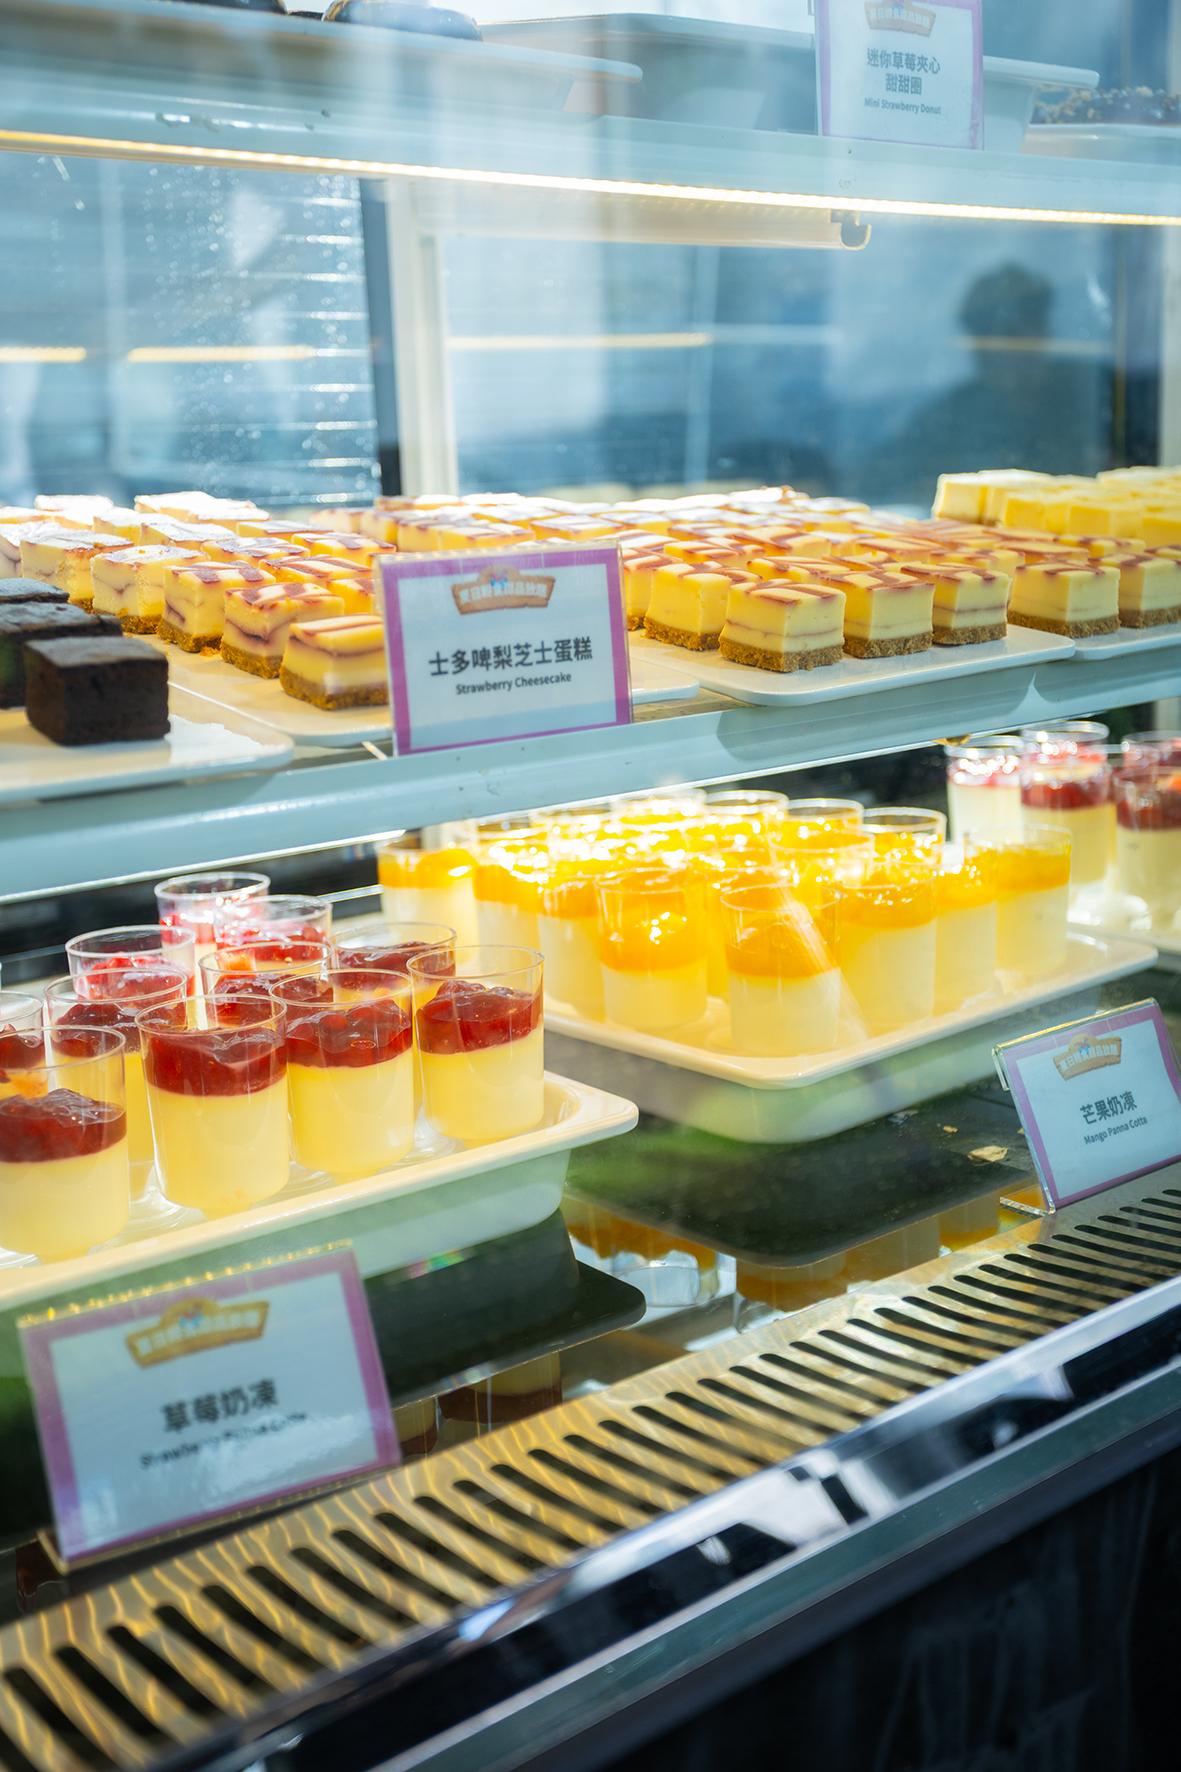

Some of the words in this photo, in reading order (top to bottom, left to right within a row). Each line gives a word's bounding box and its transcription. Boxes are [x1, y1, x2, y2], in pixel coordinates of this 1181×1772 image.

[867, 47, 941, 75] 迷你草莓夾心
[885, 73, 922, 95] 甜甜圈
[864, 97, 880, 108] Mini
[881, 100, 919, 114] Strawberry
[920, 103, 941, 114] Donut
[428, 636, 593, 676] 士多啤梨芝士蛋糕
[456, 679, 512, 695] Strawberry
[514, 672, 572, 689] Cheesecake
[1080, 1091, 1138, 1125] 芒果奶凍
[1084, 1130, 1108, 1145] Mango
[1108, 1124, 1130, 1136] Panna
[1129, 1115, 1148, 1128] Cotta
[162, 1378, 278, 1433] 草莓奶凍
